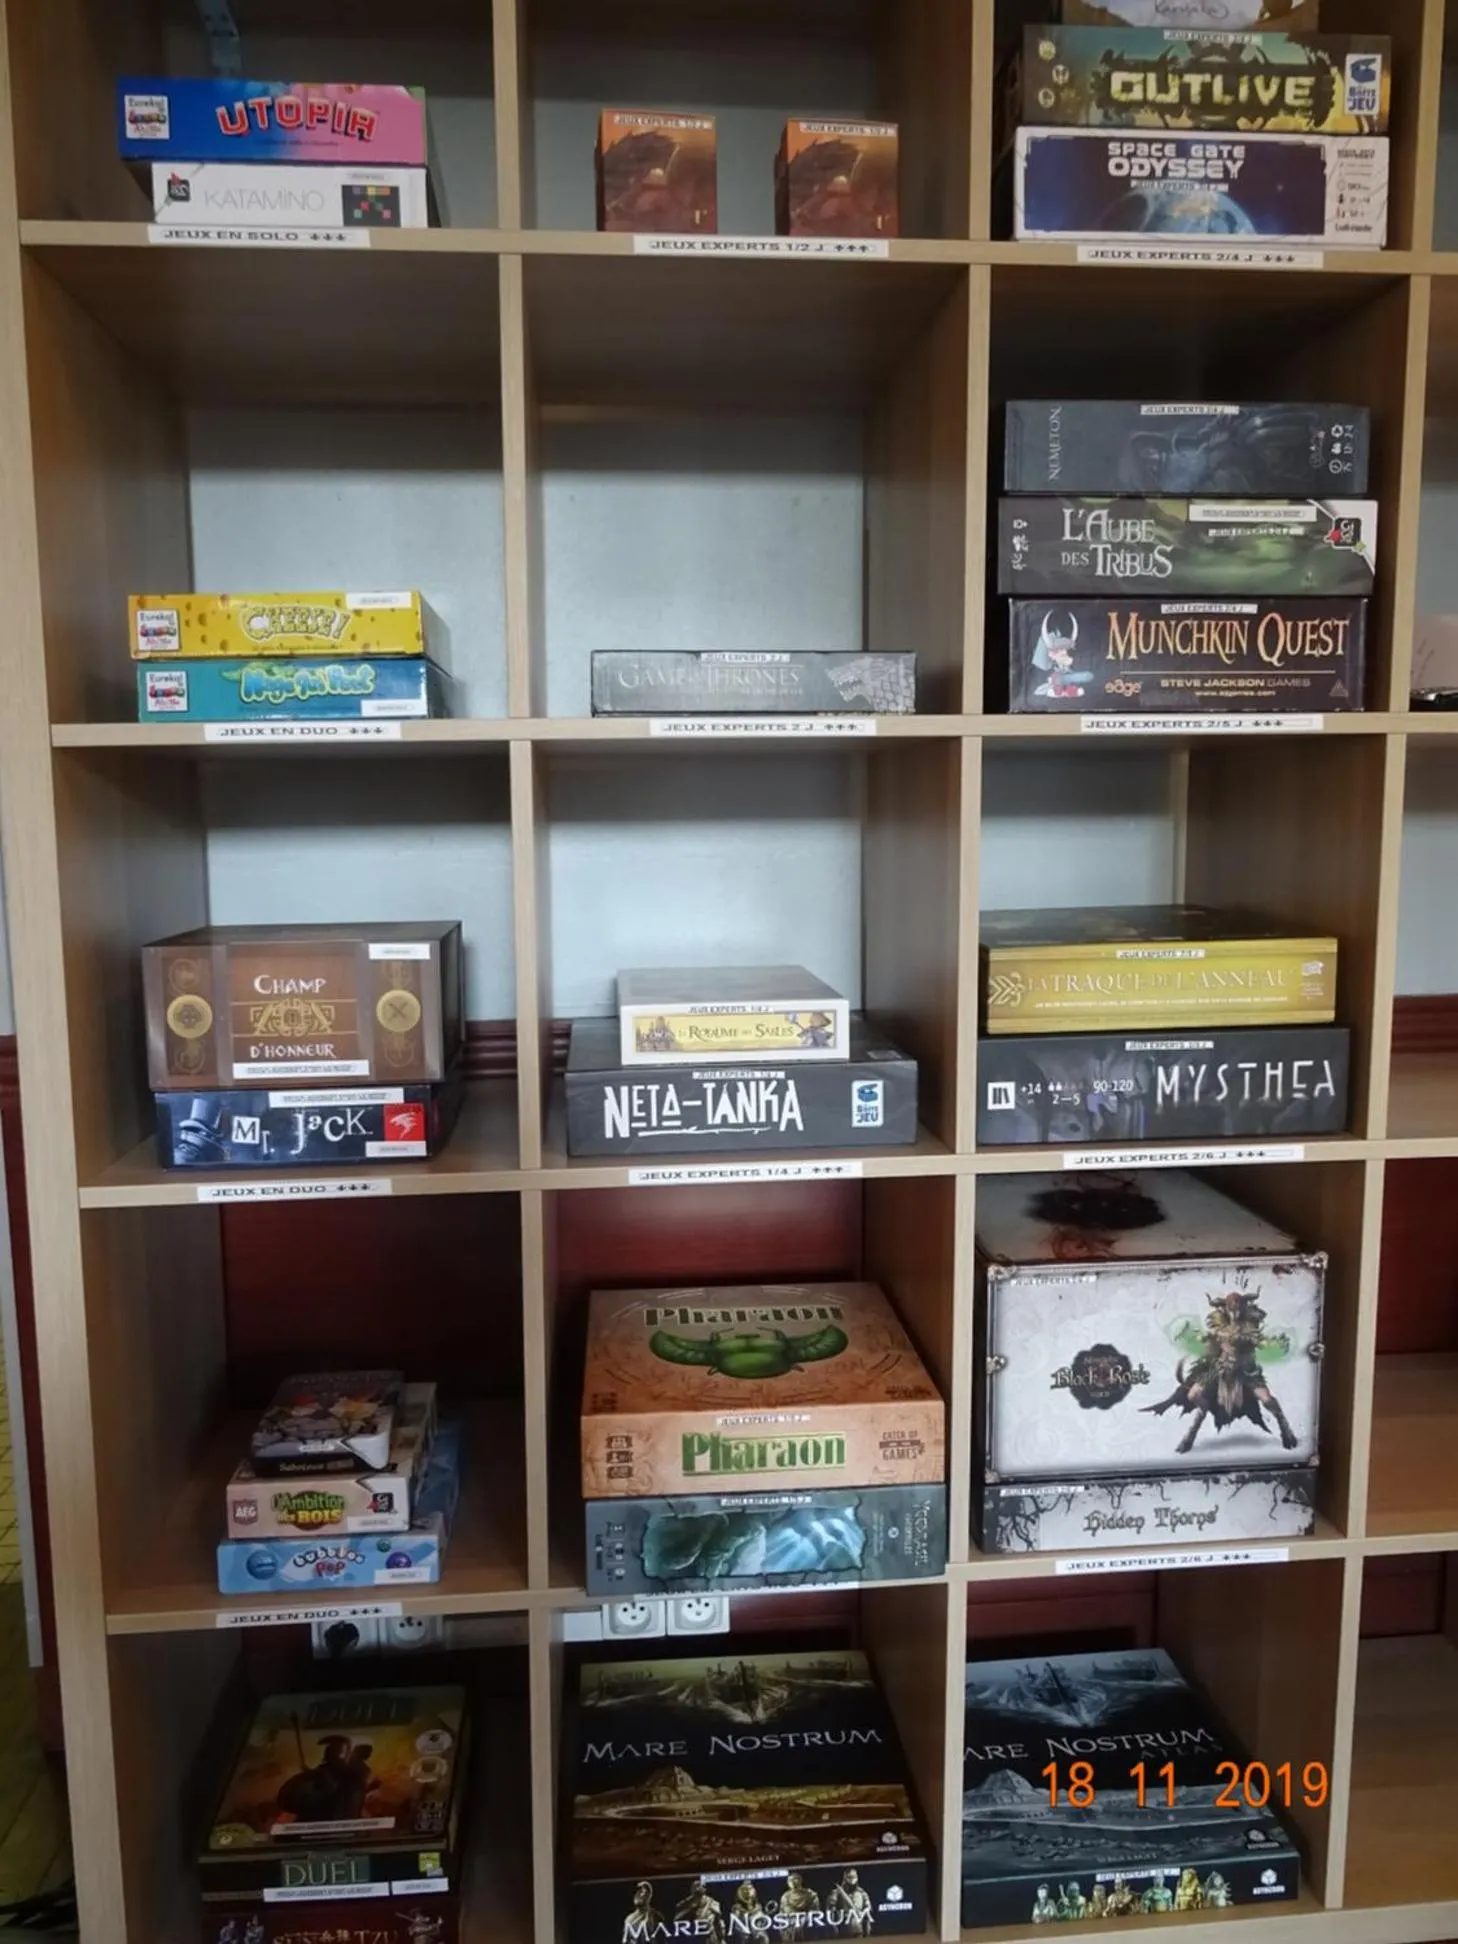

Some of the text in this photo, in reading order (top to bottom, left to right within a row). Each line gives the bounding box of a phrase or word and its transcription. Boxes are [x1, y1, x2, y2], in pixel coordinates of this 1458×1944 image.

[1110, 71, 1315, 107] OUTLIVE
[1348, 97, 1375, 111] JEU
[216, 96, 379, 143] UTOPIA
[1108, 158, 1244, 179] ODYSSEY
[204, 187, 326, 212] KATAMINO
[164, 228, 299, 241] JEUX EN SOLO
[649, 240, 824, 253] JEUX EXPERTS 1/2 J
[1088, 250, 1133, 260] JEUX
[1137, 250, 1212, 262] EXPERTS
[1048, 406, 1062, 482] NEMETON
[1062, 507, 1156, 544] L'AUBE
[1061, 545, 1173, 578] DES TRIBUS
[1106, 611, 1350, 668] MUNCHKIN QUEST
[1160, 679, 1311, 688] STEVE JACKSON GAMES
[220, 725, 338, 738] JEUX EN DUO
[663, 722, 814, 733] JEUX EXPERTS 2 J
[1084, 719, 1128, 729] JEUX
[1133, 719, 1202, 729] EXPERTS
[253, 975, 328, 996] CHAMP
[249, 1042, 338, 1060] D'HONNEUR
[1156, 1060, 1335, 1107] MYSTHEA
[603, 1080, 805, 1138] NETA-TANKA
[1074, 1154, 1115, 1164] JEUX
[1119, 1152, 1187, 1163] EXPERTS
[1193, 1151, 1215, 1162] 2/6
[639, 1170, 683, 1181] JEUX
[687, 1168, 760, 1180] EXPERTS
[768, 1167, 789, 1178] 1/4
[212, 1185, 326, 1198] JEUX EN DUO
[645, 1304, 847, 1327] Pharaon
[682, 1432, 846, 1475] Pharaon
[882, 1447, 918, 1460] GAMES
[234, 1505, 257, 1517] AEG
[297, 1508, 342, 1524] BOIS
[1084, 1509, 1147, 1536] Hidden
[1067, 1561, 1105, 1571] JEUX
[1109, 1558, 1178, 1569] EXPERTS
[230, 1609, 339, 1624] JEUX EN DUO
[583, 1728, 884, 1764] MARE NOSTRUM
[963, 1727, 1214, 1762] ARE NOSTRUM
[284, 1859, 368, 1887] DUEL
[623, 1908, 875, 1943] MARE NOSTRUM
